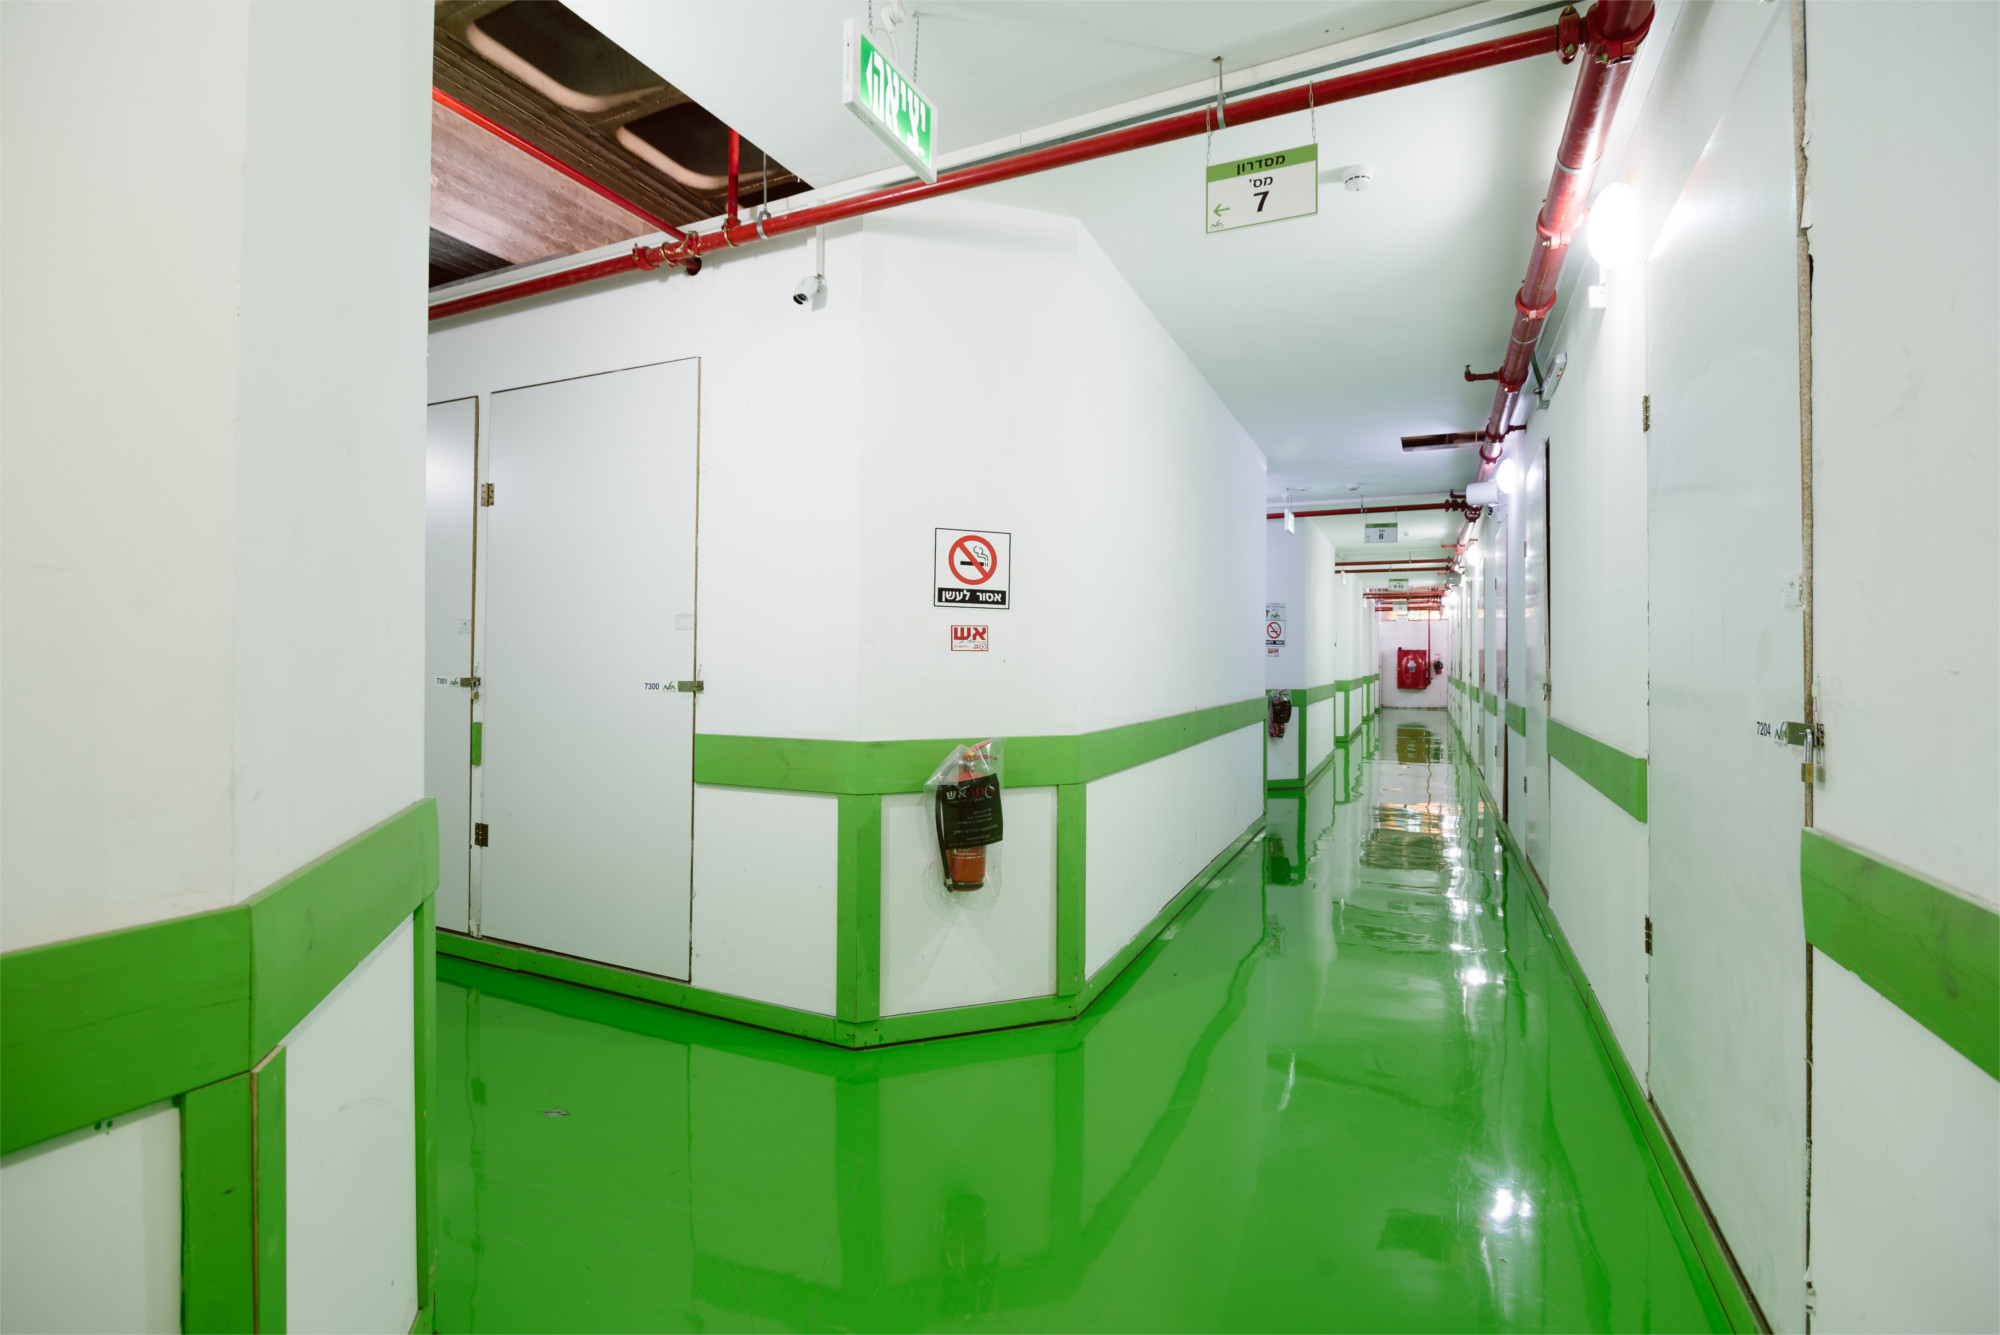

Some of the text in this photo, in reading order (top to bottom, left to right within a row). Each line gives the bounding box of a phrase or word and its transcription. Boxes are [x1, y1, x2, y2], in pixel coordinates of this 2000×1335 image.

[872, 50, 927, 157] יציאה
[1236, 155, 1286, 176] מסדרון
[1253, 190, 1270, 213] 7
[942, 590, 1002, 603] אסור לעשן
[953, 627, 987, 641] אש
[644, 682, 660, 690] 7300
[1756, 721, 1771, 738] 7204
